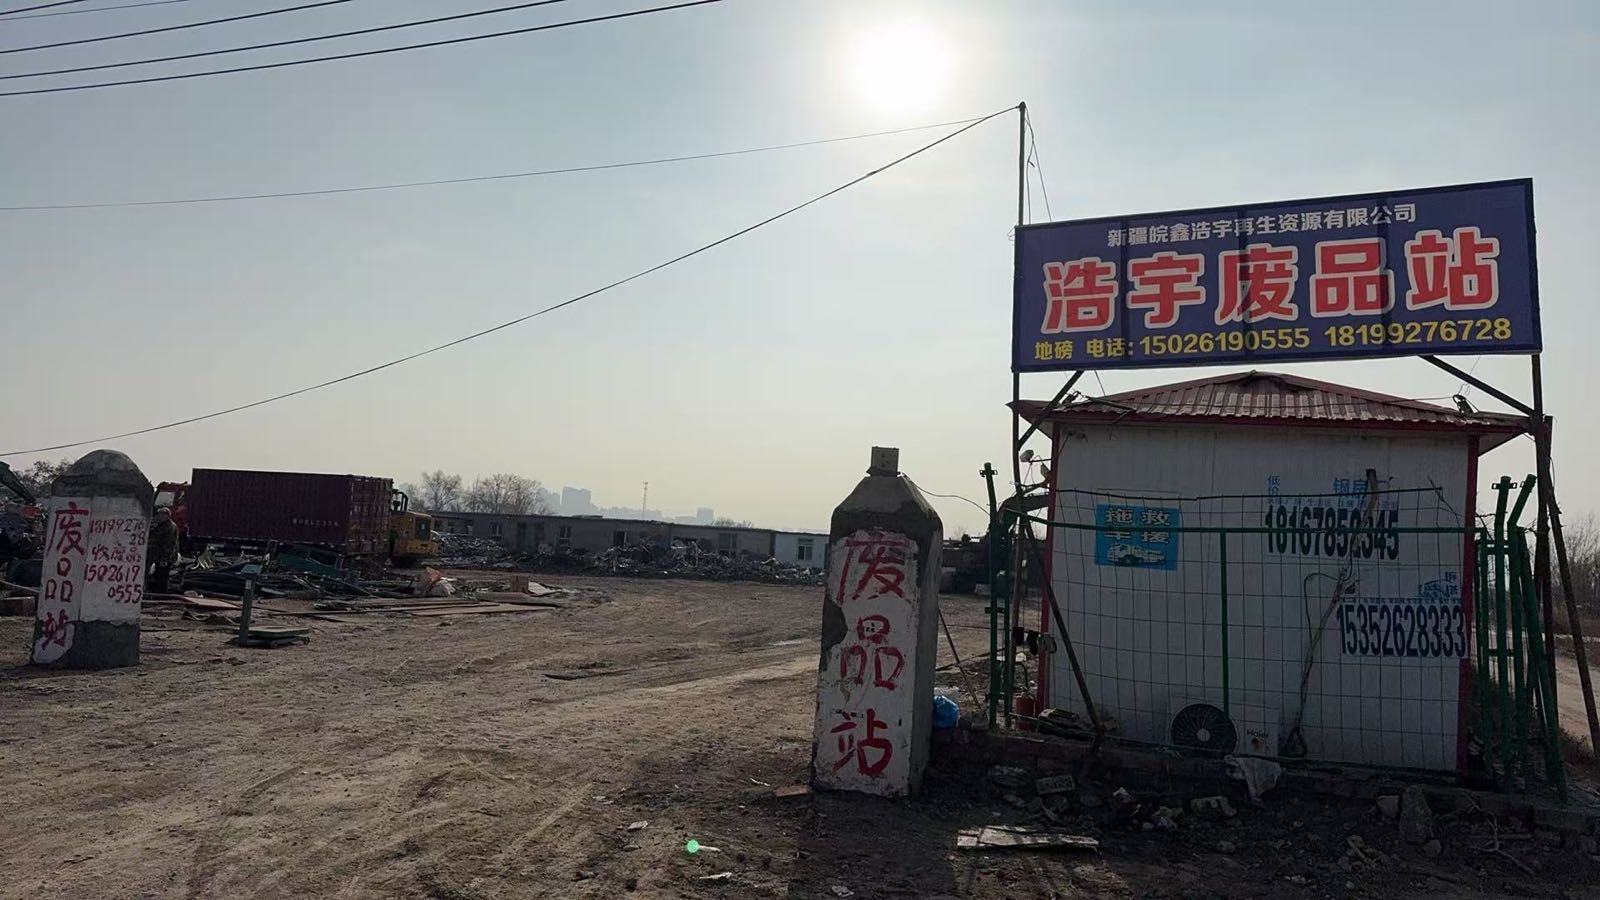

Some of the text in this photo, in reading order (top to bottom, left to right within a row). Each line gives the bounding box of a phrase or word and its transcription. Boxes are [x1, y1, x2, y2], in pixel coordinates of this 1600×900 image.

[1107, 203, 1416, 248] 新疆皖鑫浩宇再生资源有限公司
[1041, 226, 1500, 334] 浩宇废品站
[1034, 340, 1073, 360] 地磅
[1142, 327, 1310, 356] 15026190555
[1325, 317, 1511, 347] 18199276728
[41, 501, 89, 650] 废品站
[830, 530, 910, 777] 废品站
[1336, 604, 1466, 657] 15352628333
